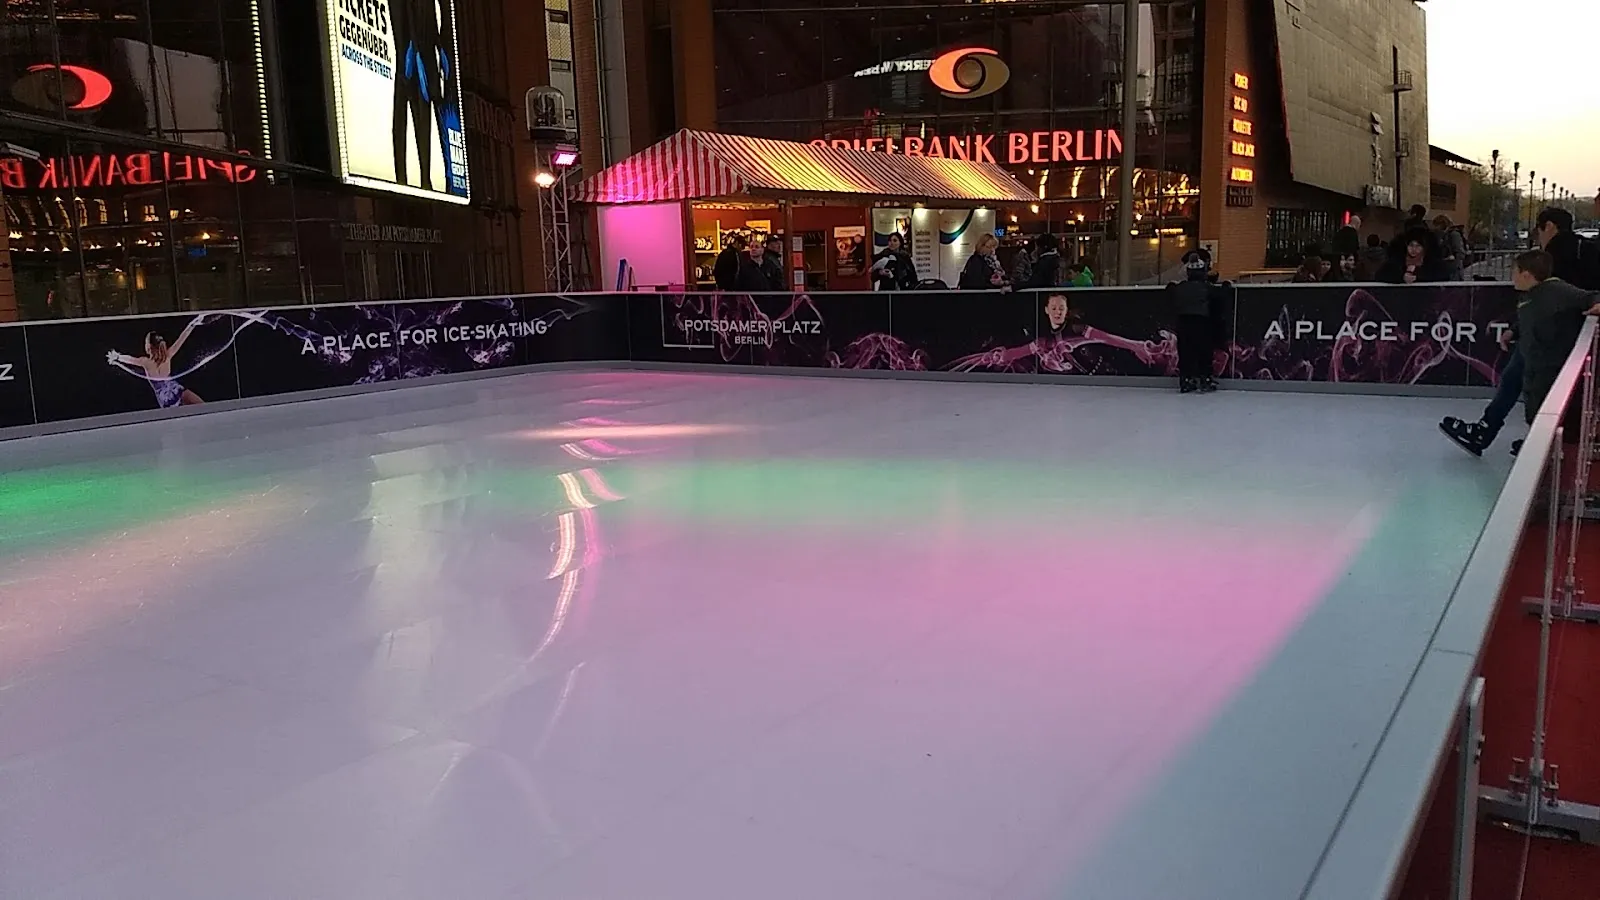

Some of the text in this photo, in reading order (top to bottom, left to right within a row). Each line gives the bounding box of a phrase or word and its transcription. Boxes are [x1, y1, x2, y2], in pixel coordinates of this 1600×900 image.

[340, 0, 388, 36] CKETS
[341, 43, 363, 67] ACROSS
[362, 54, 375, 72] THE
[1008, 128, 1122, 165] BERLIN
[300, 320, 548, 355] A PLACE FOR ICE-SKATING
[684, 319, 821, 334] POTSDAMER PLATZ
[734, 335, 767, 345] BERLIN
[1263, 321, 1286, 340] A
[1295, 320, 1398, 341] PLACE
[1410, 322, 1477, 343] FOR
